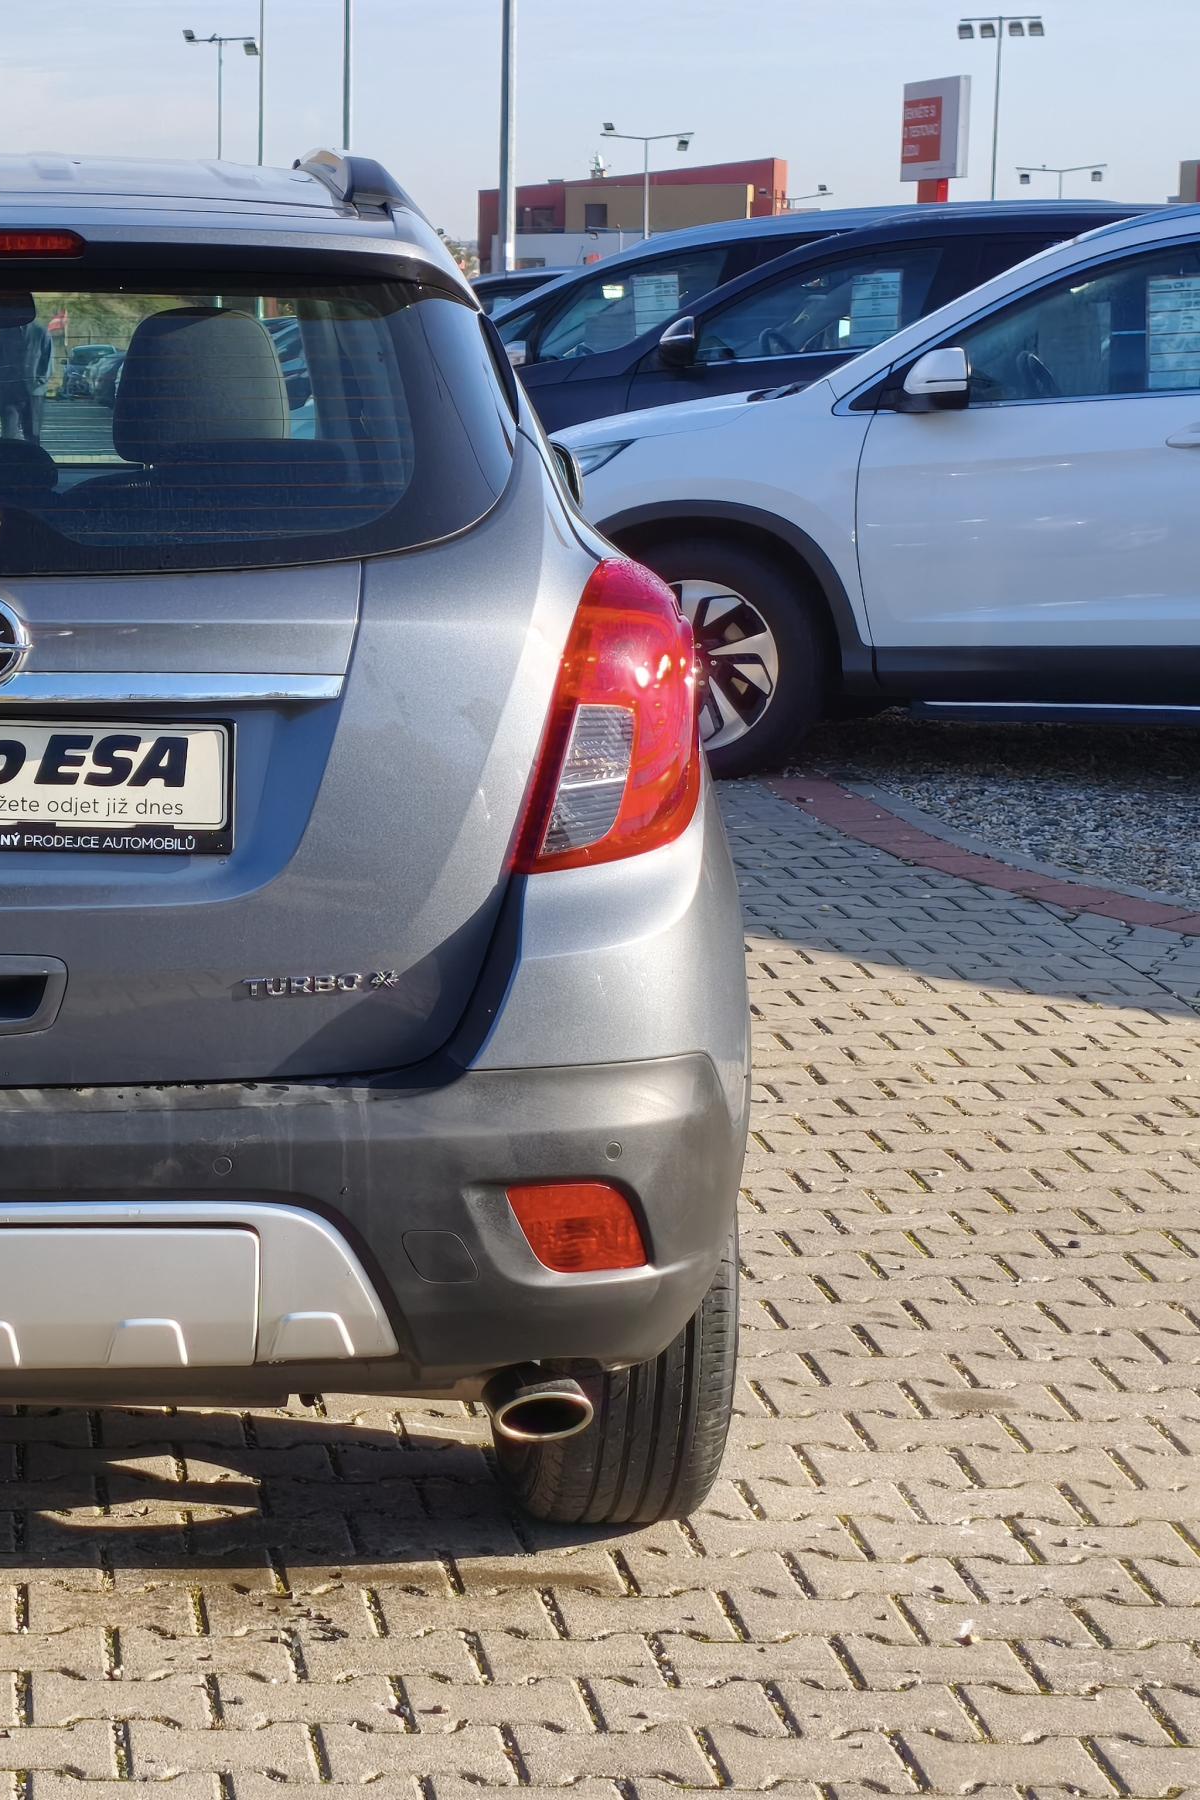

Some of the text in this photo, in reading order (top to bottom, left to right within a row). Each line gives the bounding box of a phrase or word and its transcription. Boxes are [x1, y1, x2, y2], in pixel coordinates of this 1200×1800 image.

[34, 734, 189, 788] ESA
[47, 798, 99, 817] odjet
[106, 798, 128, 817] již
[135, 799, 184, 816] dnes
[24, 835, 99, 849] PRODEJCE
[103, 835, 196, 850] AUTOMOBILŮ
[242, 973, 363, 996] TURBO
